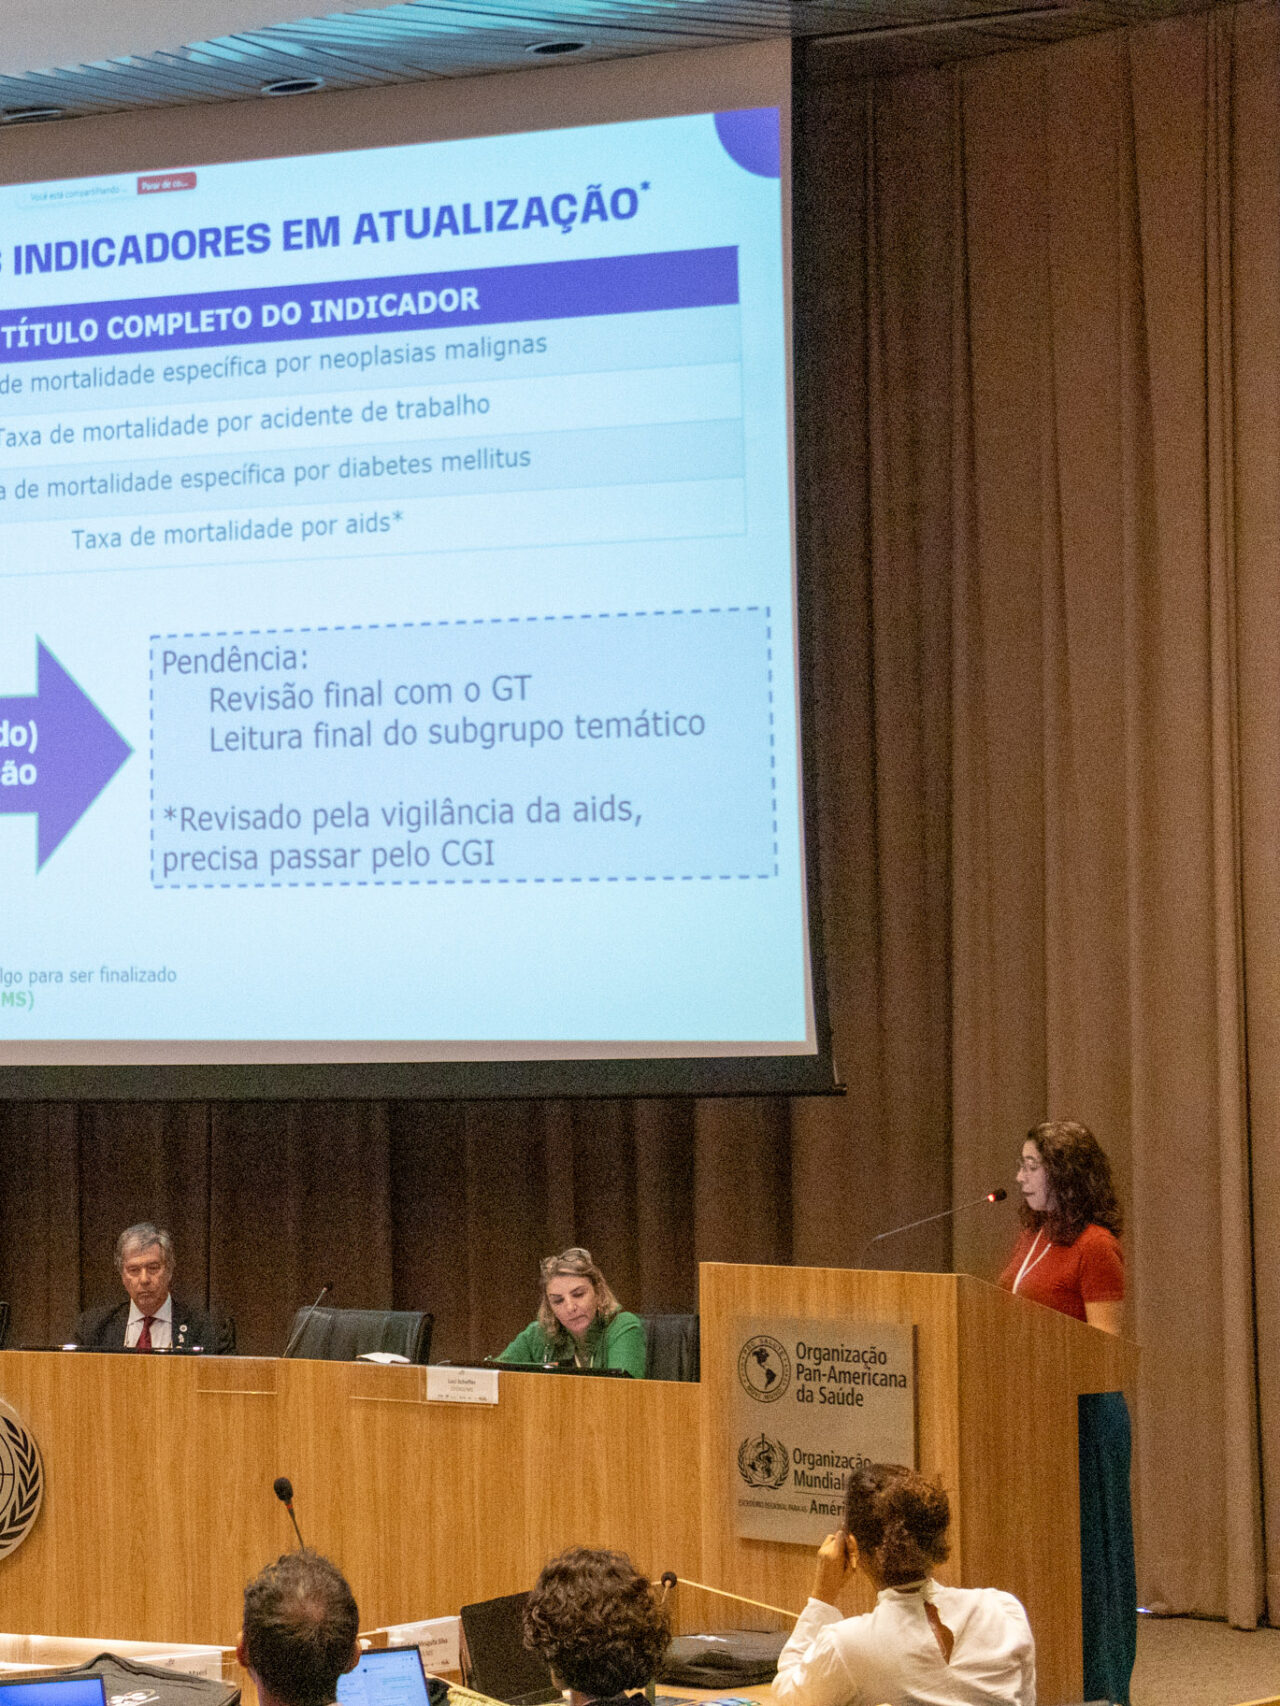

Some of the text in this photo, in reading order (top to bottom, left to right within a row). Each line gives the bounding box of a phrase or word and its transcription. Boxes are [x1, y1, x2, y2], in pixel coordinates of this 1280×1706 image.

[14, 221, 271, 275] INDICADORES
[282, 215, 341, 252] EM
[1, 287, 480, 349] TÍTULO COMPLETO DO INDICADOR
[30, 363, 156, 394] mortalidade
[162, 354, 267, 384] específica
[275, 353, 311, 379] por
[319, 340, 437, 371] neoplasias
[444, 334, 548, 363] malignas
[50, 422, 75, 446] de
[82, 412, 209, 444] mortalidade
[216, 411, 253, 436] por
[260, 403, 353, 431] acidente
[361, 400, 388, 424] de
[396, 394, 491, 422] trabalho
[15, 477, 39, 500] de
[46, 468, 173, 498] mortalidade
[180, 463, 286, 491] específica
[294, 460, 328, 485] por
[338, 452, 433, 480] diabetes
[441, 446, 532, 473] mellitus
[72, 527, 122, 551] Taxa
[130, 524, 156, 548] de
[163, 514, 295, 547] mortalidade
[302, 517, 338, 542] por
[162, 645, 309, 676] Pendência:
[209, 674, 532, 714] Revisão final com o GT
[210, 708, 706, 753] Leitura final do subgrupo temático
[312, 799, 370, 836] pela
[381, 796, 515, 833] vigilância
[525, 794, 562, 825] da
[572, 793, 643, 828] aids,
[162, 838, 495, 878] precisa passar pelo CGI
[29, 970, 64, 987] para
[70, 970, 93, 984] ser
[99, 965, 177, 983] finalizado
[796, 1340, 888, 1369] Organização
[796, 1363, 908, 1389] Pan-Americana
[796, 1384, 815, 1404] da
[819, 1386, 864, 1408] Saúde
[793, 1469, 845, 1491] Mundial
[809, 1499, 846, 1516] Améri
